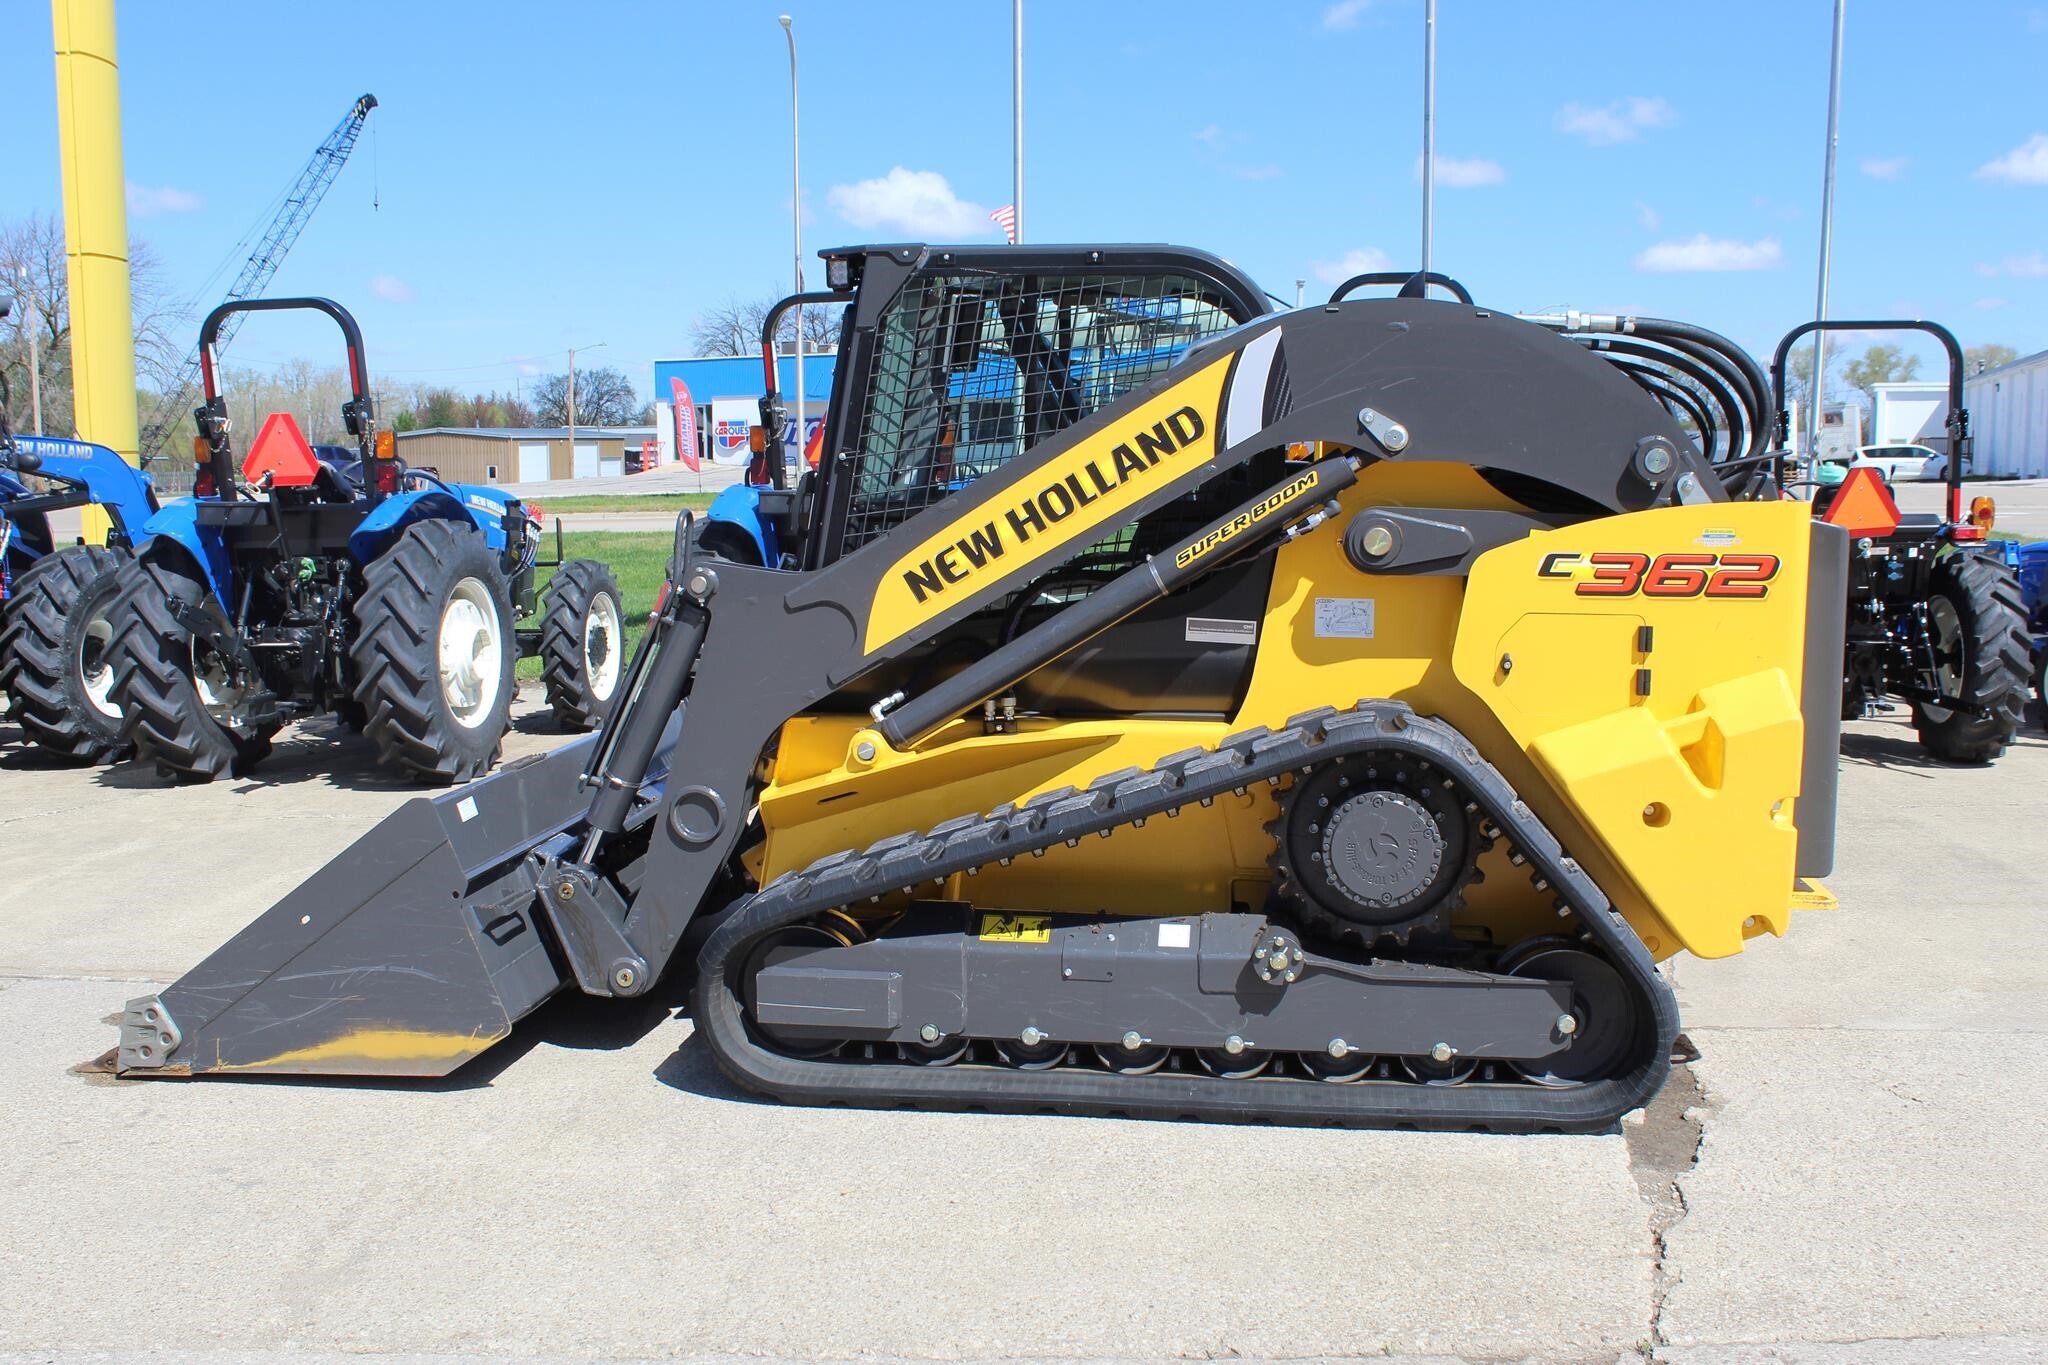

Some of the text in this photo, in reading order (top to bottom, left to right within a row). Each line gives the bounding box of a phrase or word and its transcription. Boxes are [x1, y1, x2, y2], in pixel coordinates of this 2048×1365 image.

[14, 440, 93, 459] EW HOLLAND
[714, 426, 750, 436] CARQUES
[902, 405, 1206, 605] NEW HOLLAND
[1176, 472, 1316, 567] SUPER BOOM
